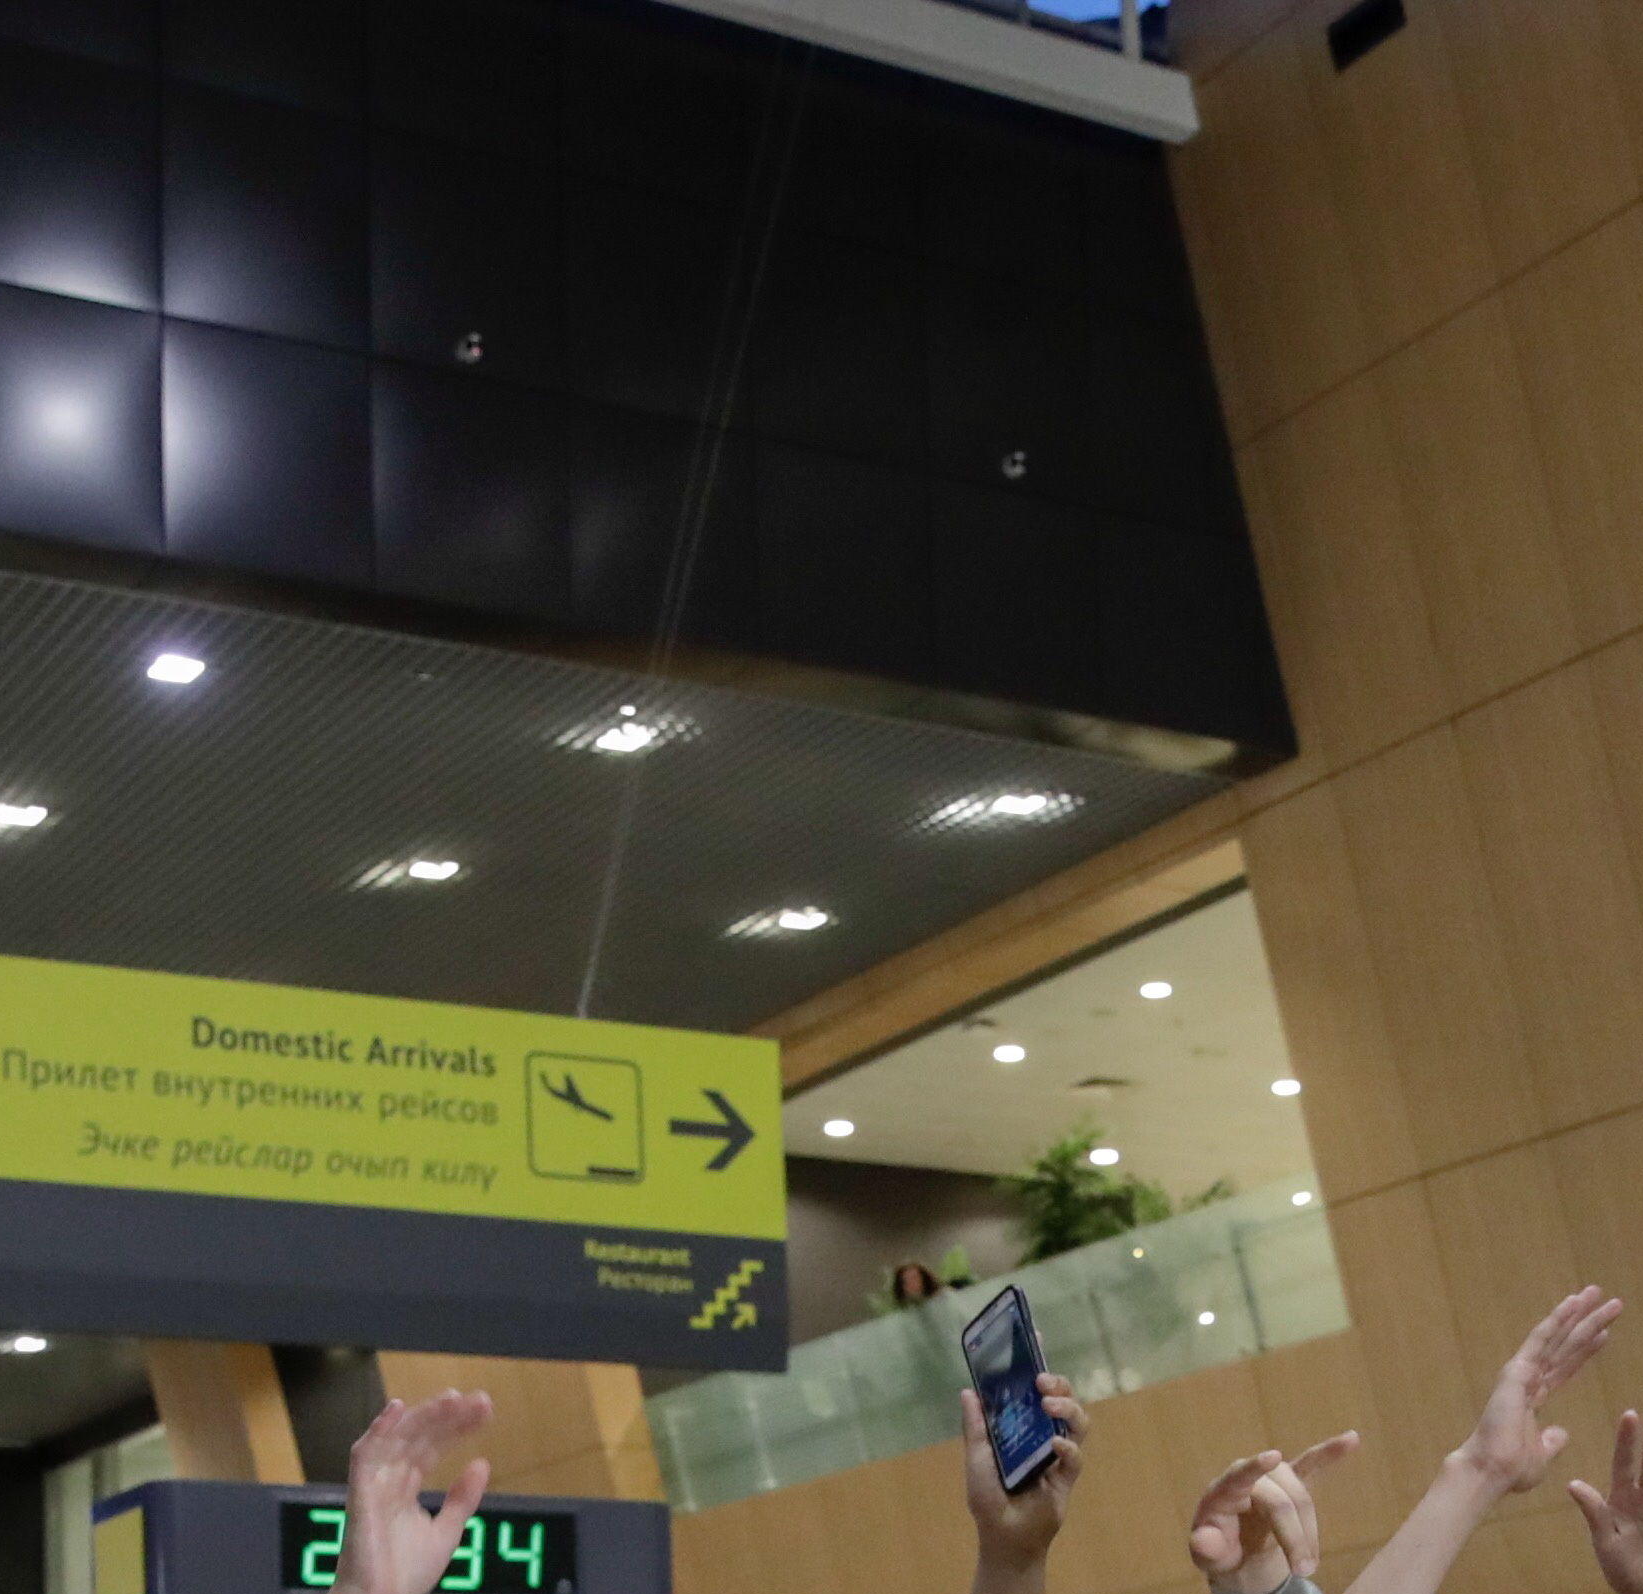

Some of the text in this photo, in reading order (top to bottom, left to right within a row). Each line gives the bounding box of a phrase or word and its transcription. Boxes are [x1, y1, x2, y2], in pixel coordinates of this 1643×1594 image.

[190, 1015, 497, 1078] Domestic Arrivals
[0, 1046, 499, 1126] Прилет внутренних рейсов
[76, 1121, 159, 1161] Эчке
[170, 1136, 313, 1177] рейслар
[326, 1151, 409, 1182] очып
[583, 1239, 692, 1267] Restaurant
[597, 1265, 695, 1292] Ресторан
